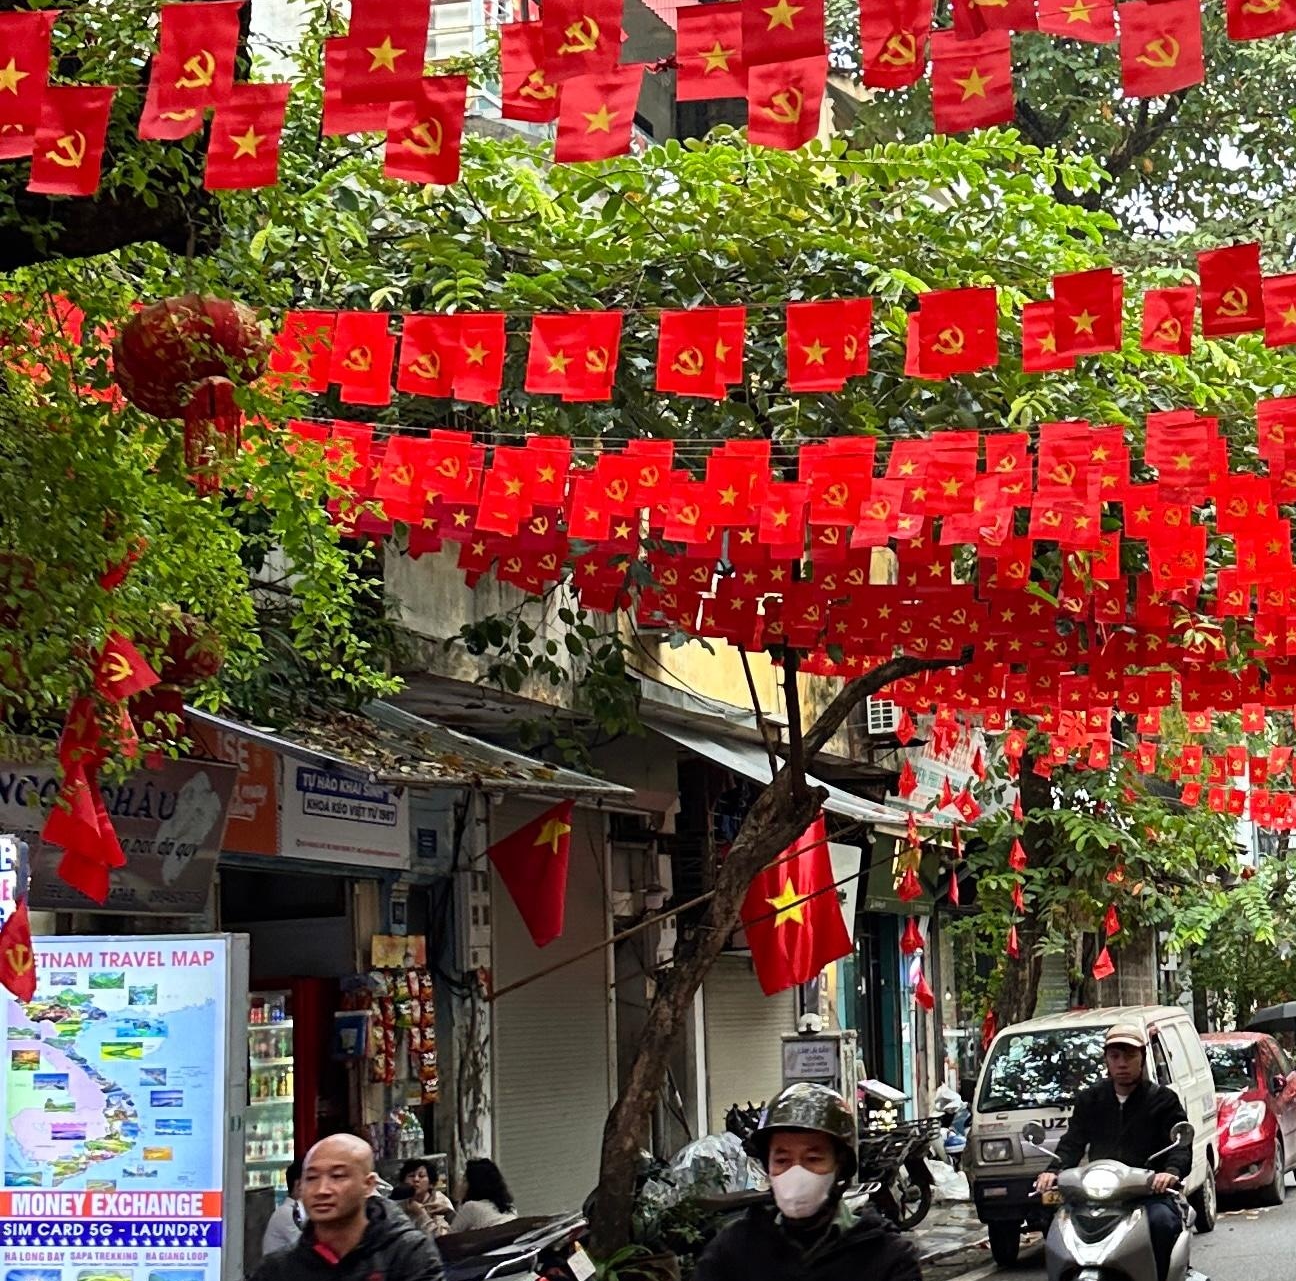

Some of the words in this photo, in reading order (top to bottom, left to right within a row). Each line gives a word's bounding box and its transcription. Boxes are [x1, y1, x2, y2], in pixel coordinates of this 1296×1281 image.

[100, 951, 165, 967] TRAVEL
[171, 950, 215, 967] MAP
[11, 1193, 86, 1216] MONEY
[92, 1193, 204, 1216] EXCHANGE
[3, 1223, 32, 1236] SIM
[37, 1223, 84, 1236] CARD
[89, 1223, 113, 1236] 5G
[131, 1223, 211, 1237] LAUNDRY
[4, 1252, 17, 1262] HA
[19, 1252, 44, 1262] LONG
[47, 1252, 65, 1261] BAY
[70, 1252, 92, 1260] SAPA
[95, 1252, 138, 1260] TREKKING
[145, 1252, 157, 1260] HA
[159, 1252, 184, 1260] GIANG
[187, 1252, 208, 1260] LOOP
